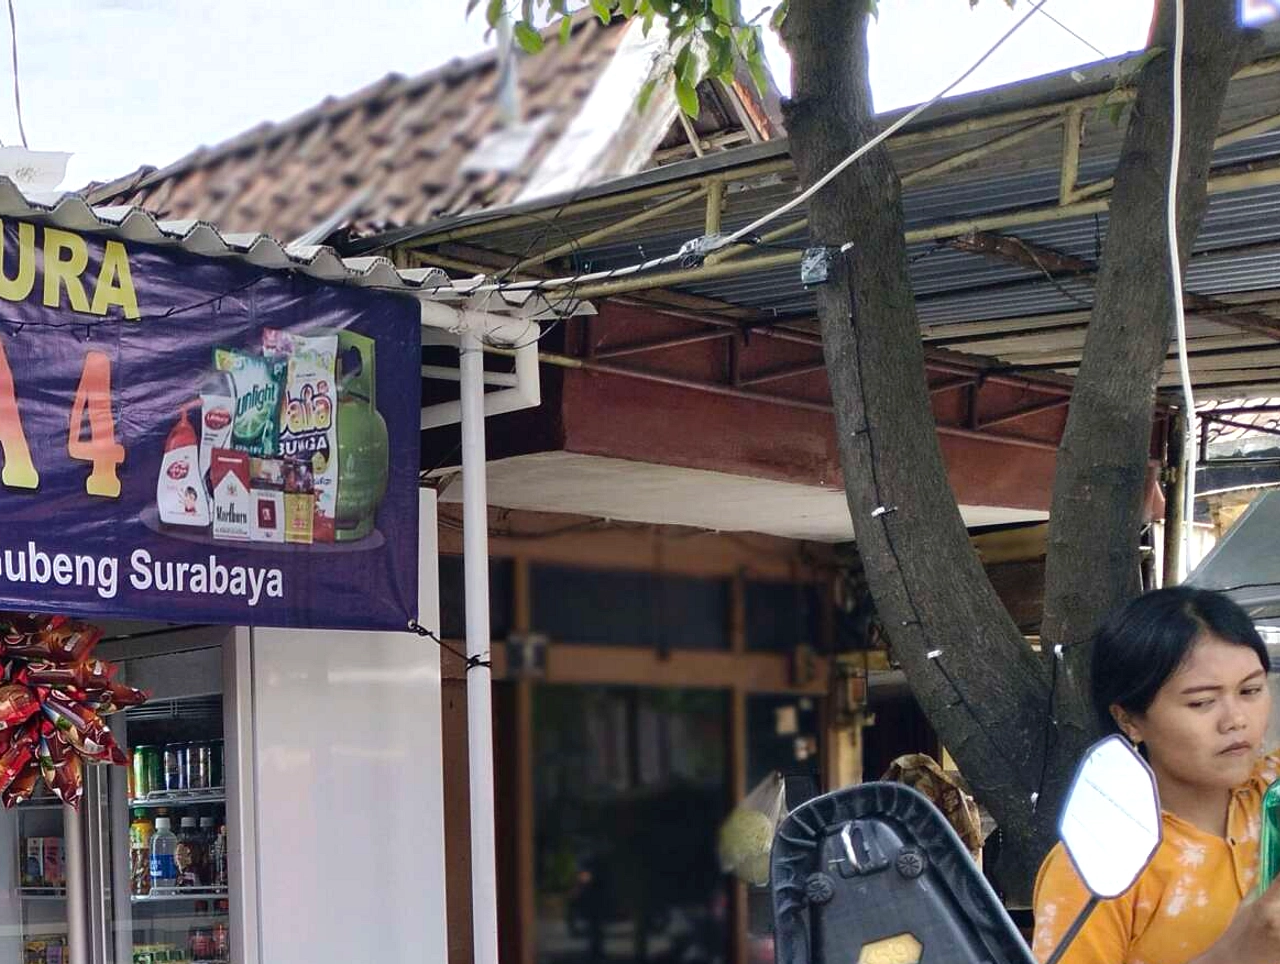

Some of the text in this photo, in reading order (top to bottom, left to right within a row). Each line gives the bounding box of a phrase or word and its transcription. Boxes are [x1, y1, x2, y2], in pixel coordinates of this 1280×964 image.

[68, 350, 125, 497] 4
[237, 383, 276, 415] unlight
[129, 549, 284, 606] Surabaya
